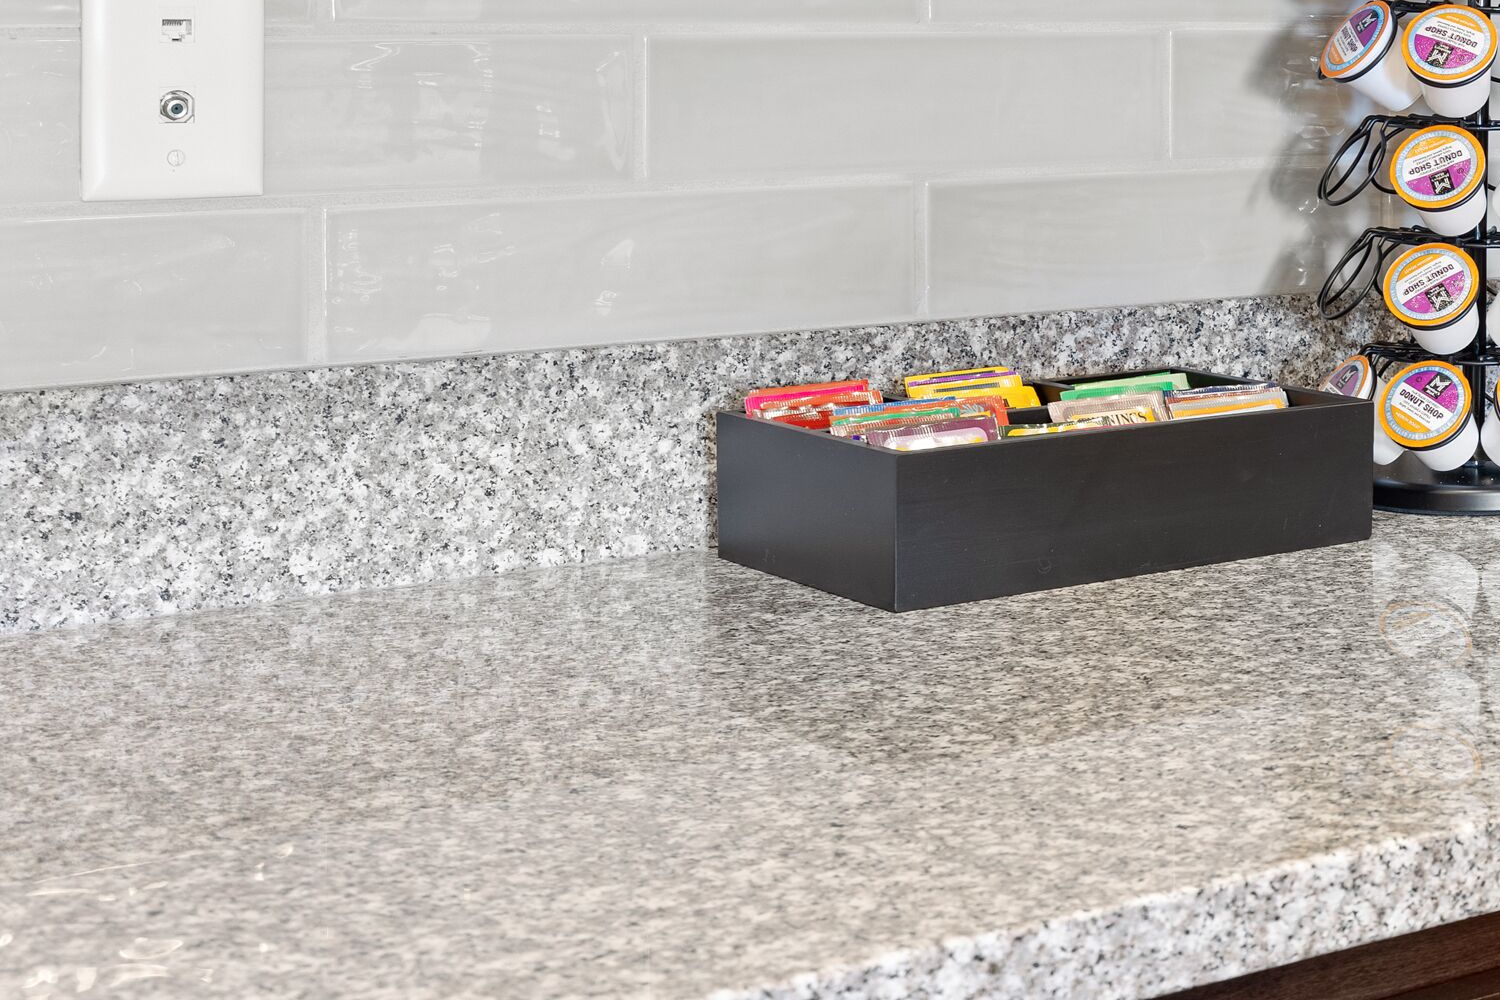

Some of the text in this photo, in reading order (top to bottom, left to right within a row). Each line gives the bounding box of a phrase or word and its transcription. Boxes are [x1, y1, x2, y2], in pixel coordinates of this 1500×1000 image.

[1424, 25, 1478, 48] DONUT SHOP
[1409, 149, 1463, 175] DONUT SHOP
[1427, 263, 1455, 283] DONUT
[1404, 279, 1425, 296] SHOP
[1399, 388, 1444, 420] DONUT SHOP
